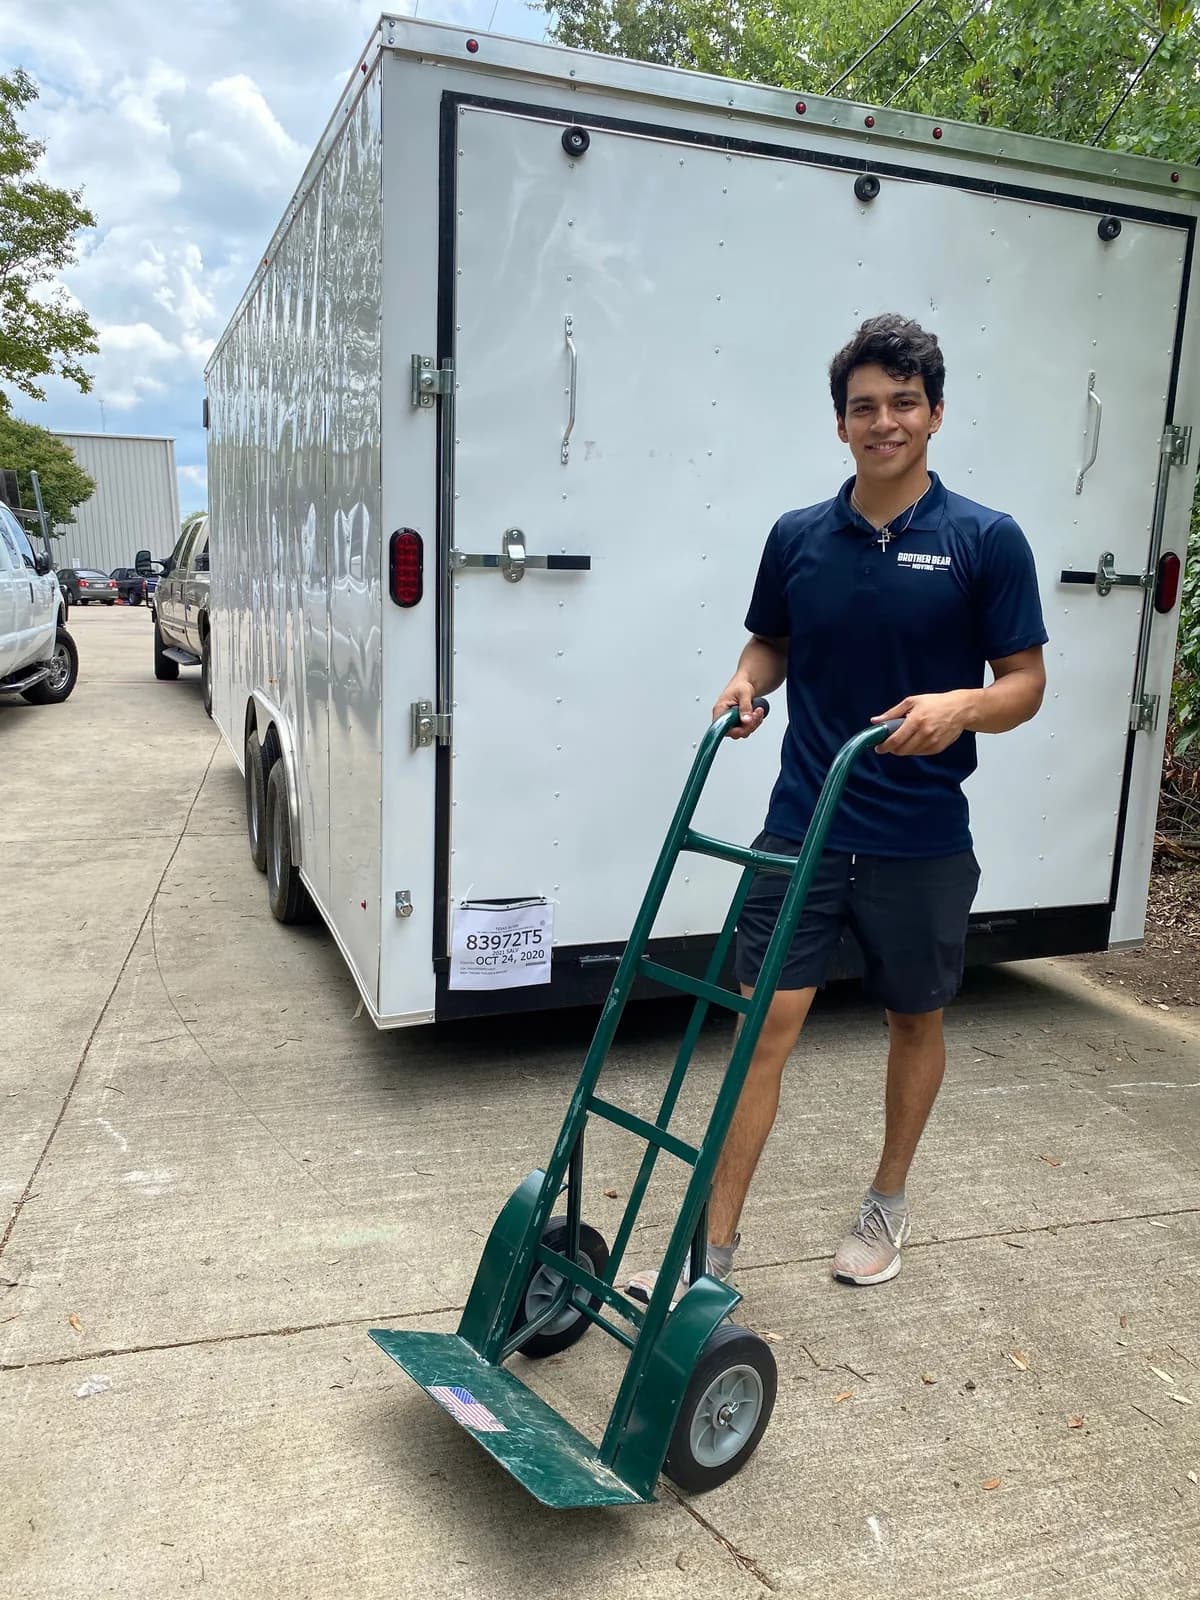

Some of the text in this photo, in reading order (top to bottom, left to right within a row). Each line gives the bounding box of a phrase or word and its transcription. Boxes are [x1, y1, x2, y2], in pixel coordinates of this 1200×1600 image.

[898, 552, 951, 566] BROTHER BEAR
[912, 563, 934, 571] MOVING
[466, 929, 542, 950] 83972T5
[475, 956, 499, 966] OCT
[501, 954, 517, 964] 24,
[520, 949, 545, 961] 2020
